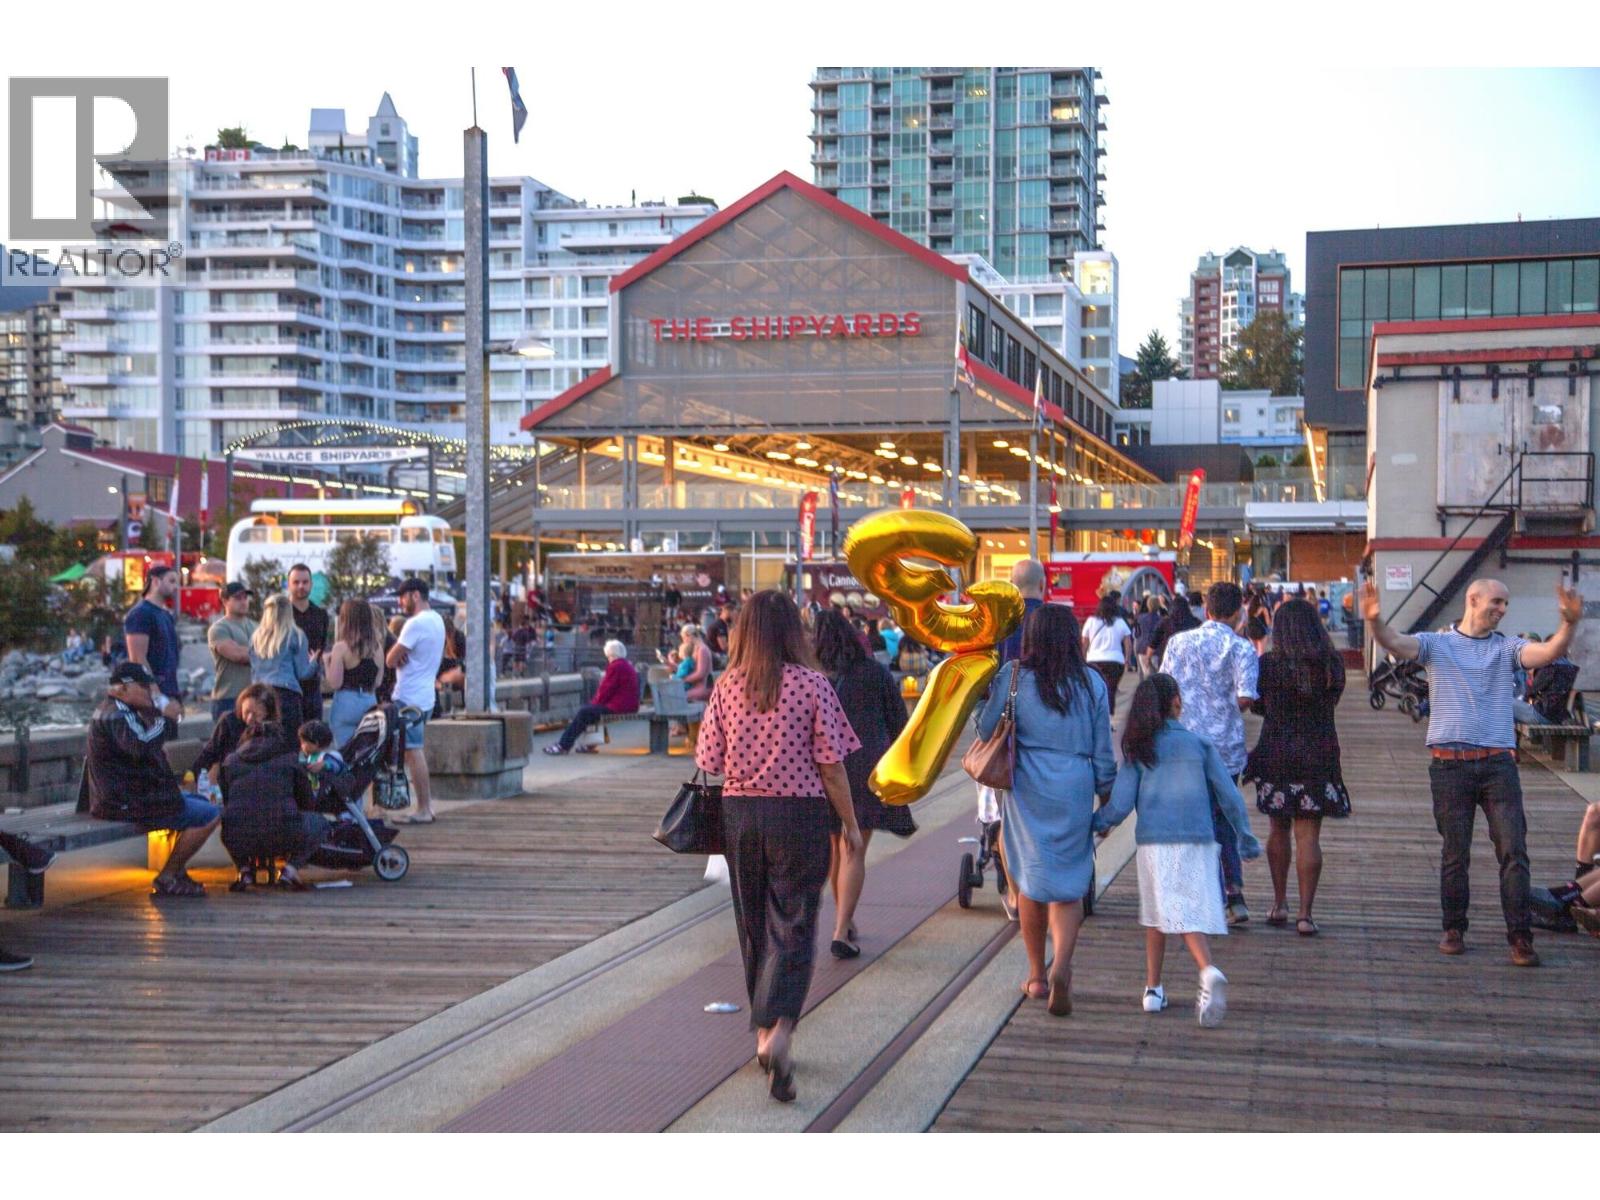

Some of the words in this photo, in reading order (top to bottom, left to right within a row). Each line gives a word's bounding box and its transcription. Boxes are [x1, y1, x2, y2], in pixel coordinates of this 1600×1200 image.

[650, 318, 714, 342] THE
[730, 311, 921, 341] SHIPYARDS
[256, 451, 313, 462] WALLACE
[321, 451, 392, 462] SHIPYARDS
